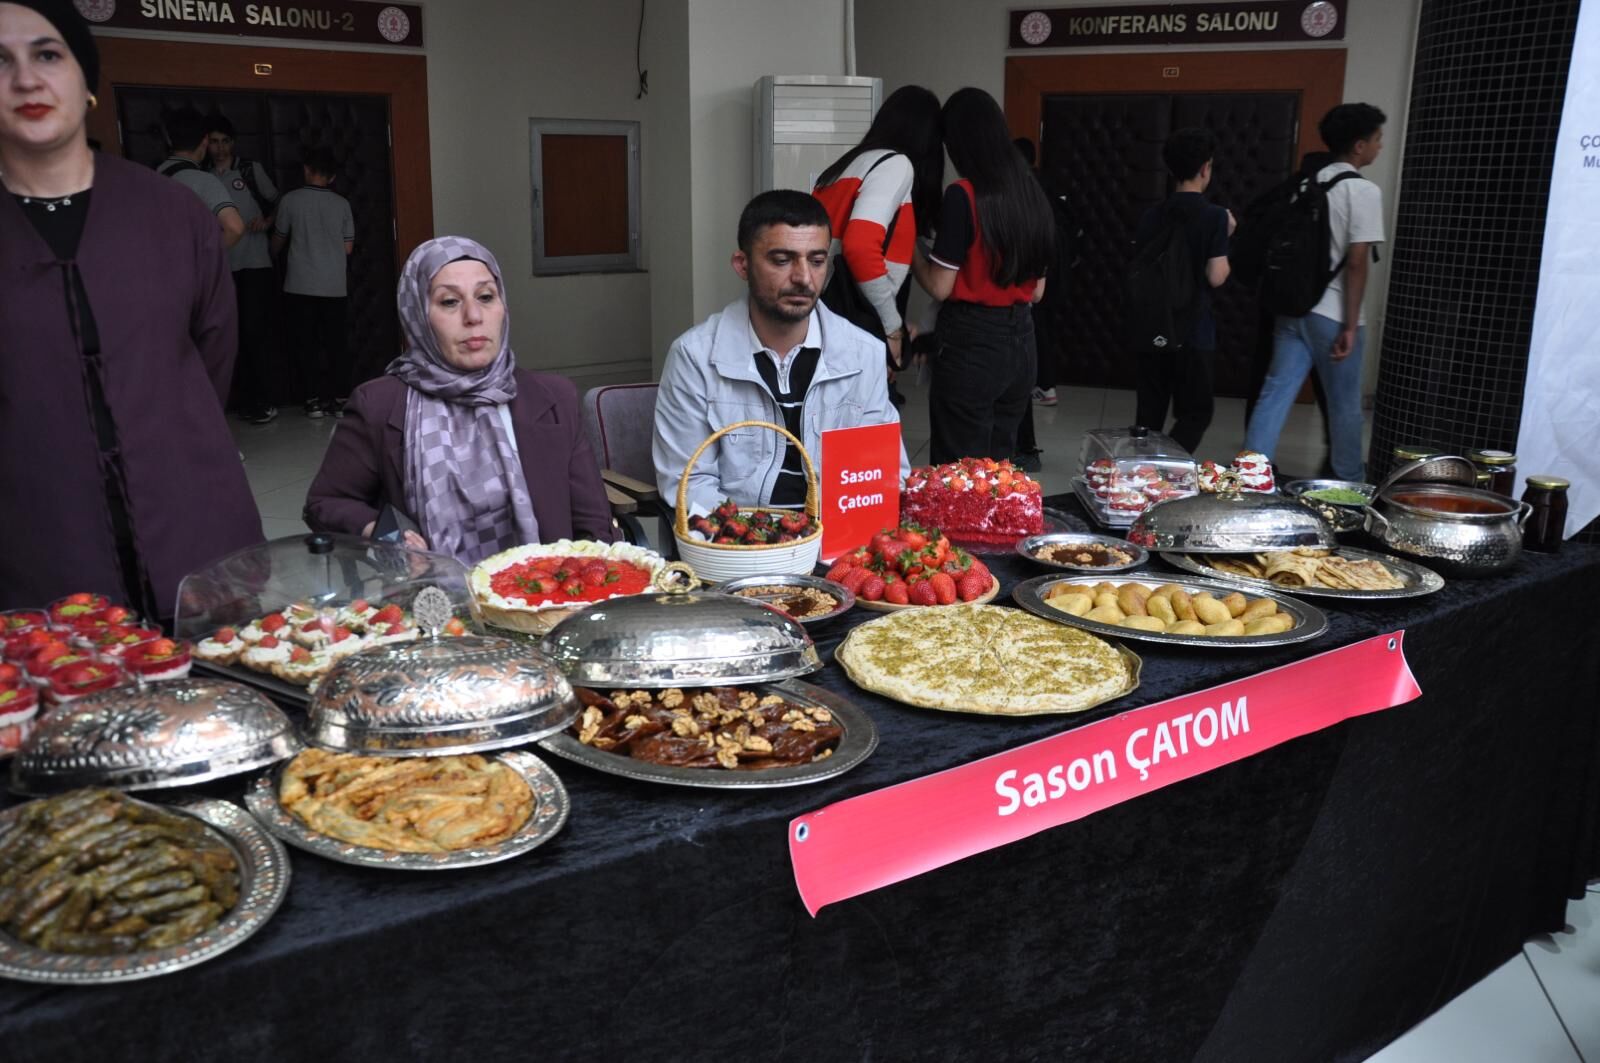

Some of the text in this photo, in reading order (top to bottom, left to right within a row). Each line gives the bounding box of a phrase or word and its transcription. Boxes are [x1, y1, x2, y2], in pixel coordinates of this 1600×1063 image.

[246, 4, 354, 31] SALONU-2
[1069, 11, 1278, 35] KONFERANS SALONU
[840, 468, 882, 485] Sason
[838, 493, 883, 514] Çatom
[995, 696, 1250, 816] Sason ÇATOM
